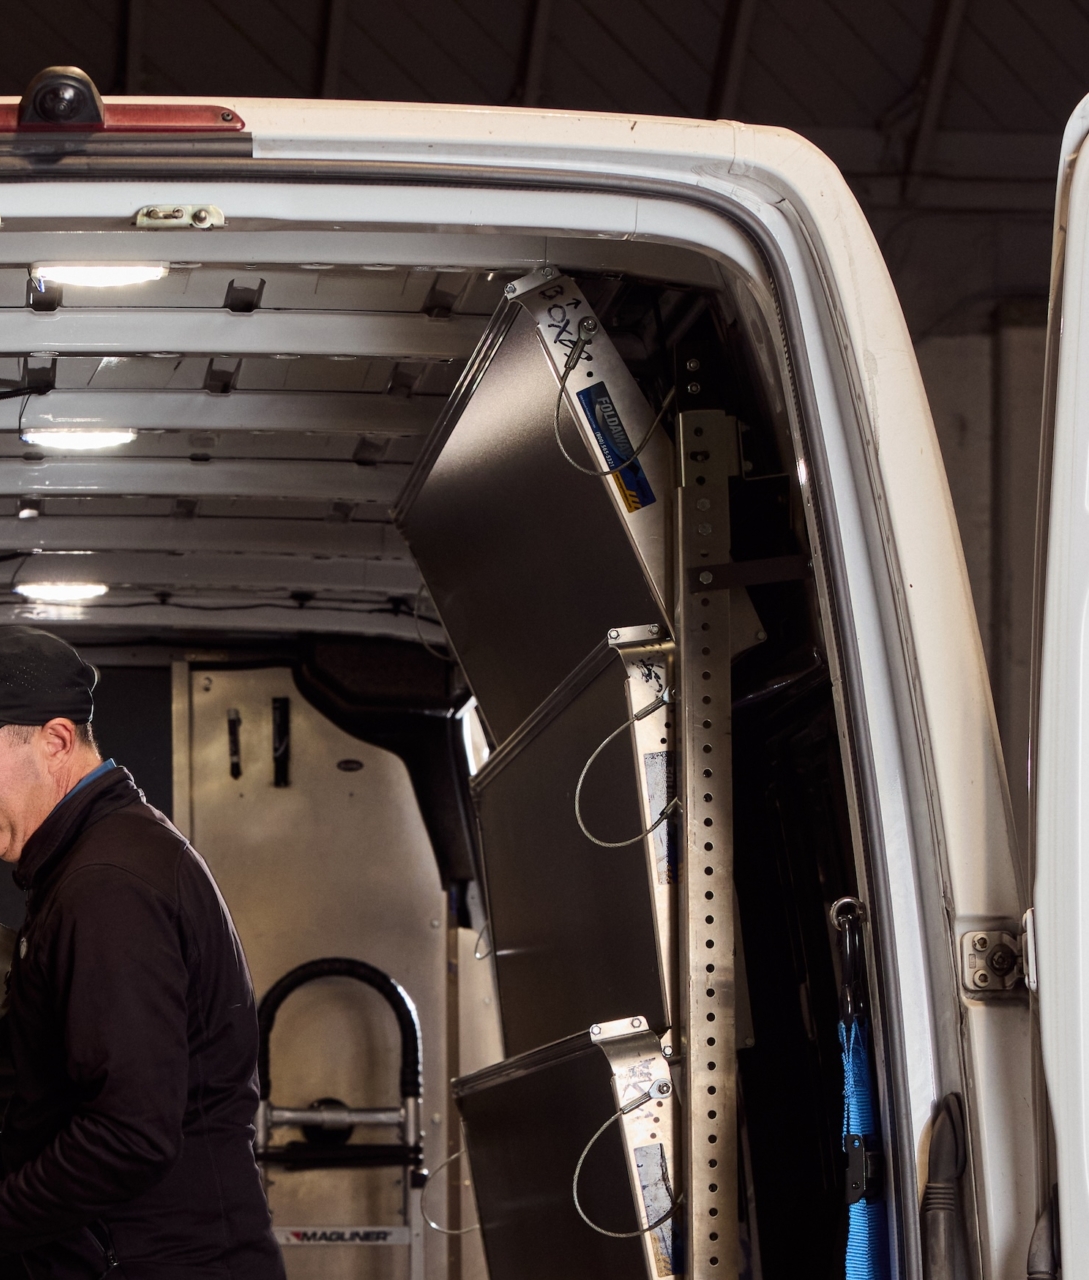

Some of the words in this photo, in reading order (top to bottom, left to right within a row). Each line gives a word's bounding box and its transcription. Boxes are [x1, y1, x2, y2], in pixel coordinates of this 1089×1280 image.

[597, 396, 634, 459] FOLDAWAY
[595, 431, 604, 449] (800)
[302, 1230, 389, 1242] MAGLINER
